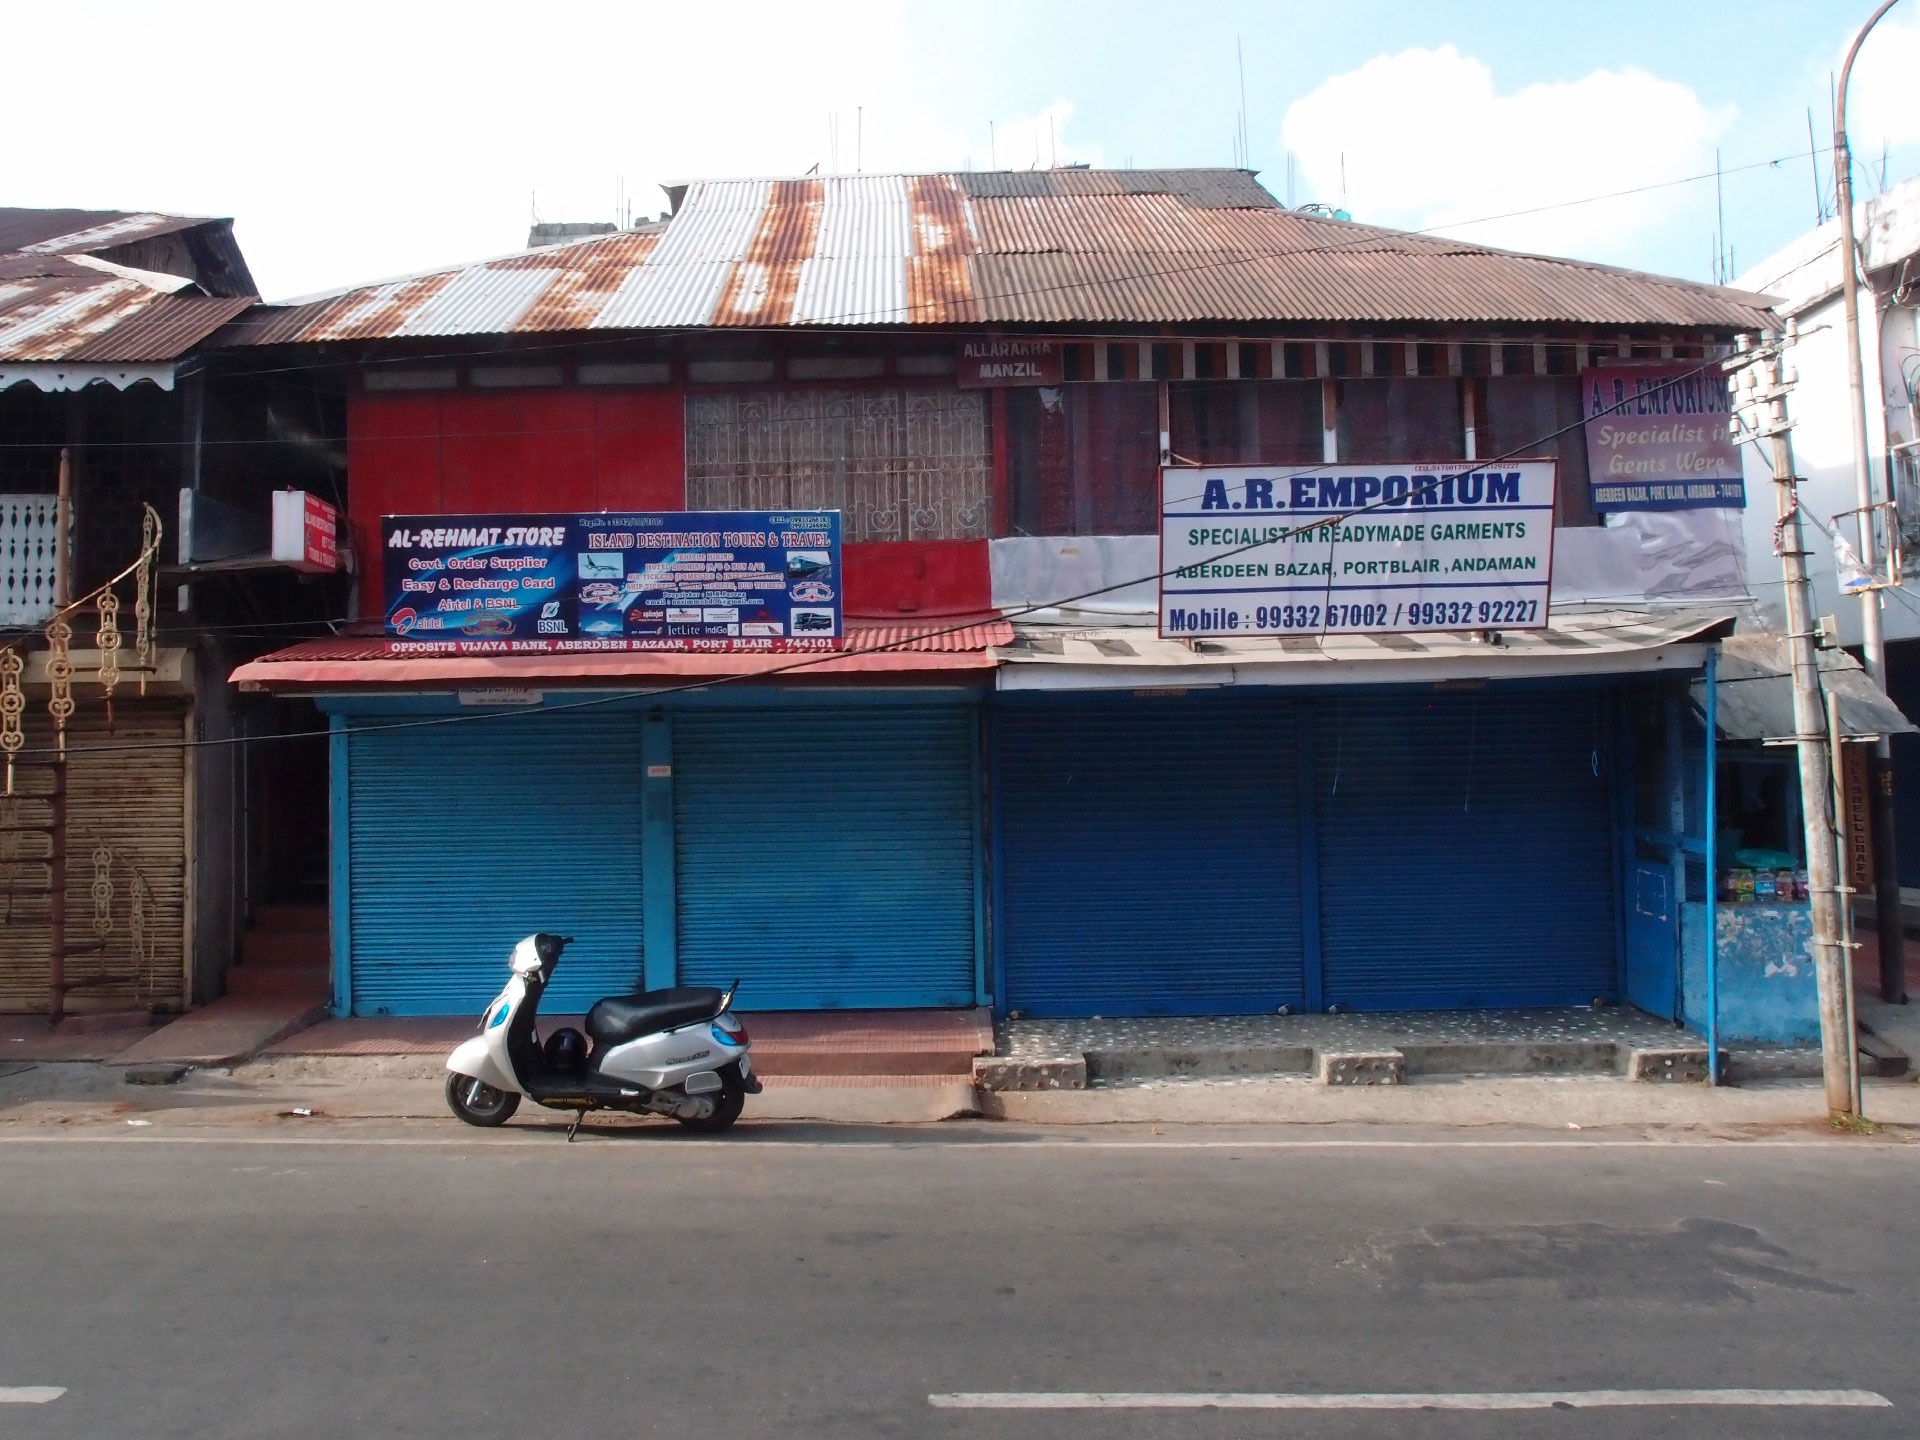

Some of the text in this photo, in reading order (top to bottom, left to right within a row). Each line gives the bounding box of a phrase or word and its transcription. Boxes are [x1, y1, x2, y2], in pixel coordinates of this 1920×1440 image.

[979, 362, 1042, 378] MANZIL
[1636, 376, 1730, 414] EMPORIUM
[1598, 424, 1705, 449] Specialist
[1609, 452, 1725, 474] Gents Were
[388, 527, 566, 549] AL-REHMAT STORE
[589, 531, 831, 549] ISLAND DESTINATION TOURS & TRAVEL
[1188, 522, 1526, 545] SPECIALIST IN READYMADE GARMENTS
[408, 557, 547, 571] Govt. Order Supplier
[674, 553, 734, 562] VEHICLE HIRING
[645, 563, 670, 572] HOTEL
[1175, 562, 1268, 579] ABERDEEN
[1274, 562, 1337, 578] BAZAR,
[627, 573, 641, 581] AIR
[643, 572, 674, 581] TICKETS
[402, 577, 555, 592] Easy & Recharge Card
[626, 582, 642, 591] SHIP
[754, 581, 787, 590] TICKETS
[437, 598, 520, 611] Airtel & BSNL
[1169, 607, 1239, 631] Mobile
[1256, 604, 1320, 629] 99332
[1326, 603, 1388, 627] 67002
[1393, 602, 1403, 626] /
[1408, 601, 1473, 626] 99332
[1478, 600, 1538, 623] 92227
[418, 618, 444, 630] airtel
[538, 620, 568, 634] BSNL
[668, 624, 700, 636] JetLite
[705, 624, 728, 635] IndiGo
[391, 640, 457, 652] OPPOSITE
[461, 640, 508, 651] VIJAYA
[511, 640, 552, 652] BANK,
[555, 639, 628, 650] ABERDEEN
[632, 639, 689, 650] BAZAAR,
[692, 639, 729, 650] PORT
[733, 638, 773, 649] BLAIR
[785, 638, 833, 649] 744101
